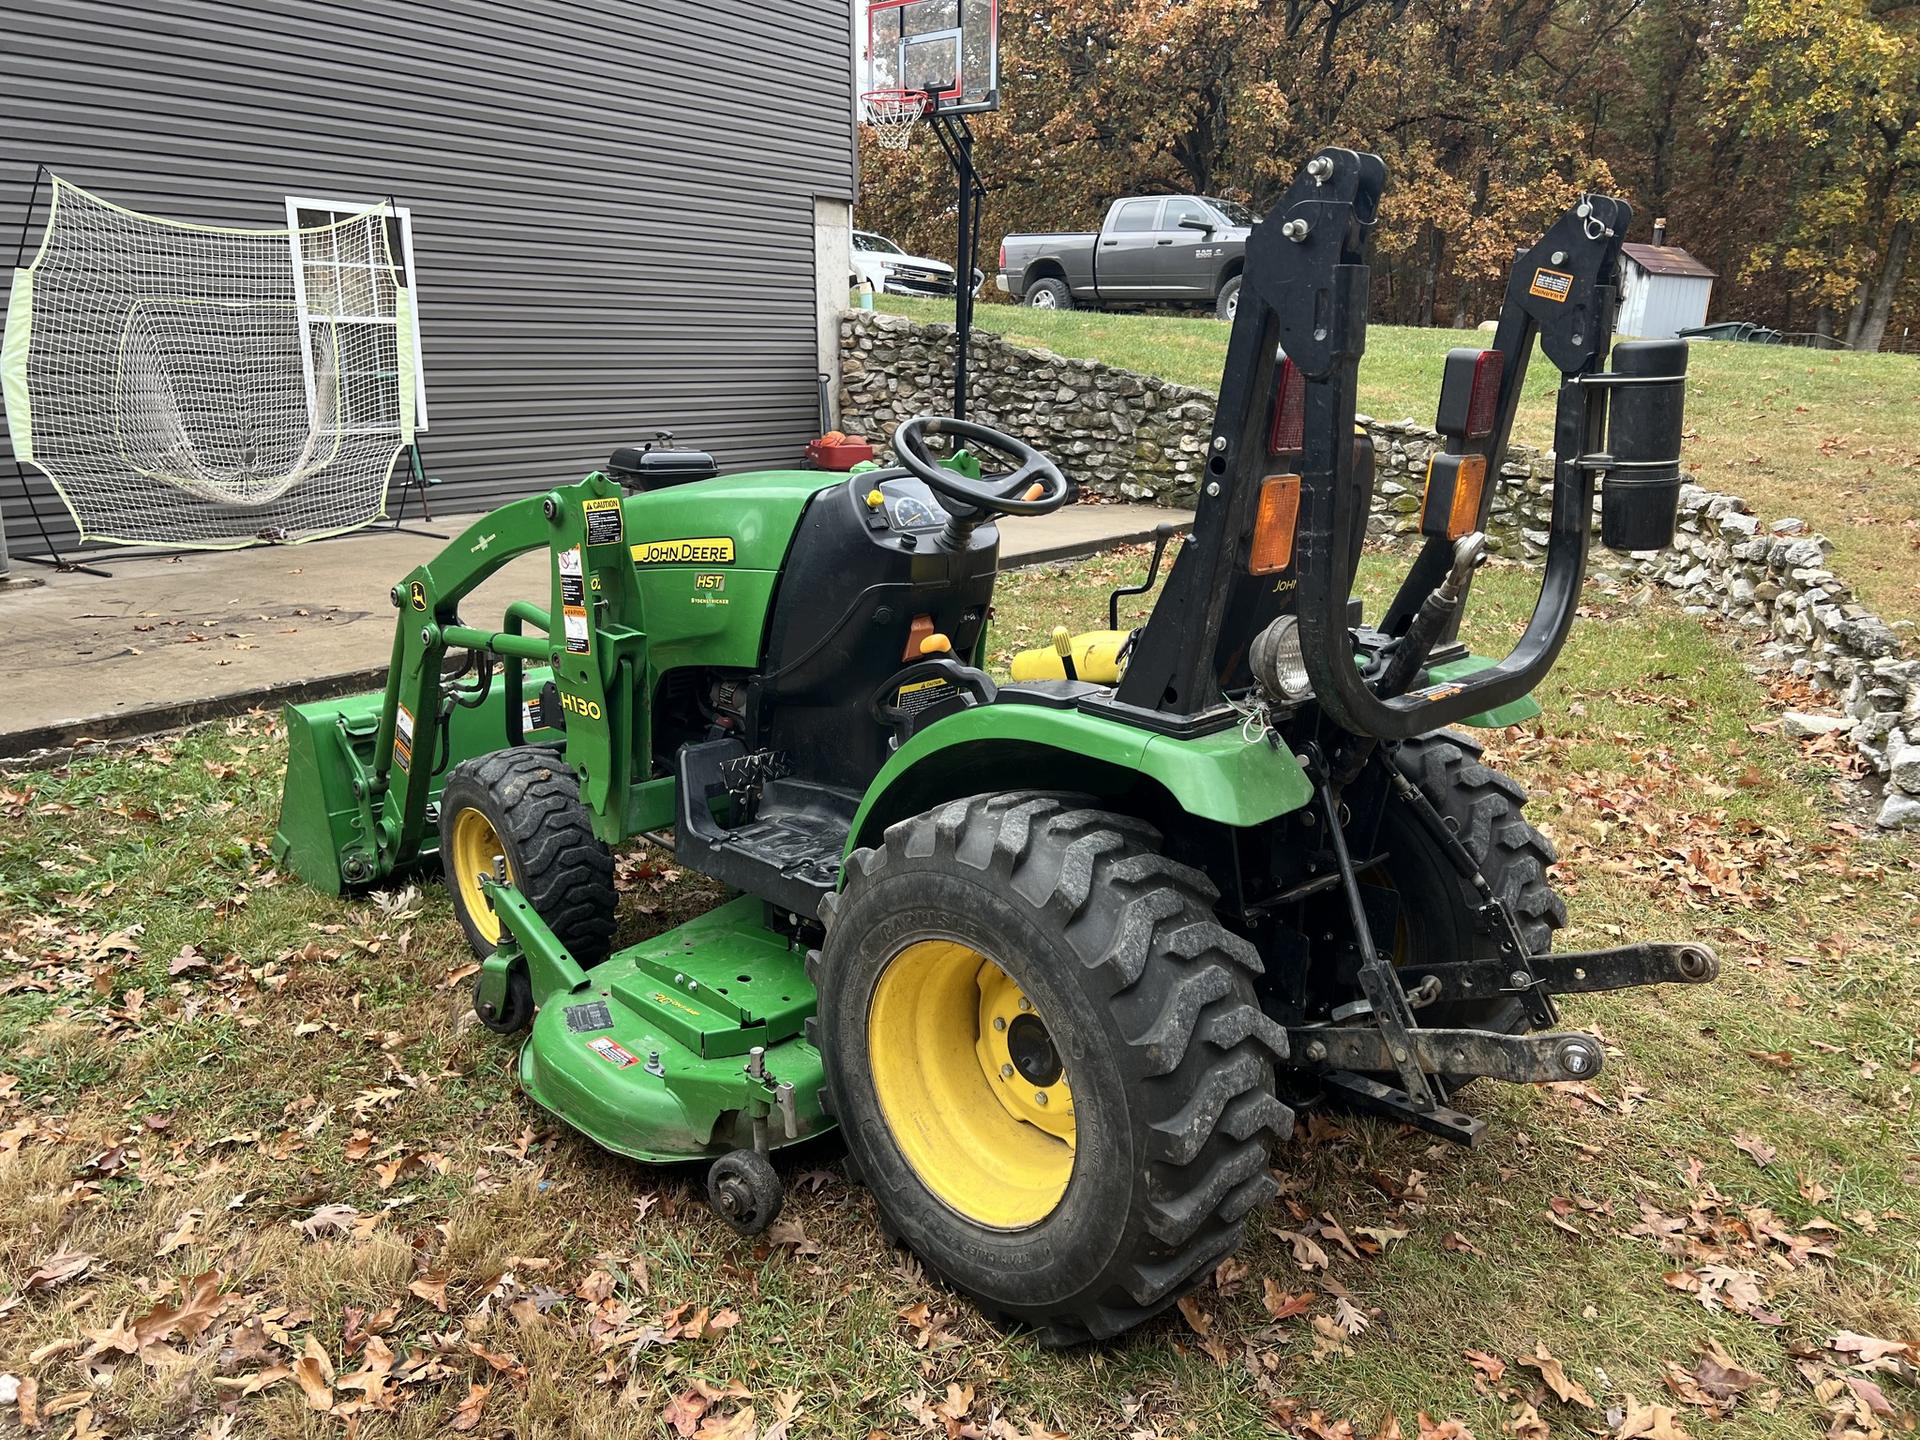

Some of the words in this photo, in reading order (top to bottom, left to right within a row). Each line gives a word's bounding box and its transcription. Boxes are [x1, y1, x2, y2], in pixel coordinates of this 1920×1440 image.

[1532, 287, 1559, 299] WARNING
[593, 500, 618, 510] CAUTION
[643, 546, 679, 560] JOHN
[682, 544, 728, 560] DEERE
[696, 575, 723, 588] HST
[560, 691, 602, 720] H130
[879, 910, 978, 939] CARLISLE
